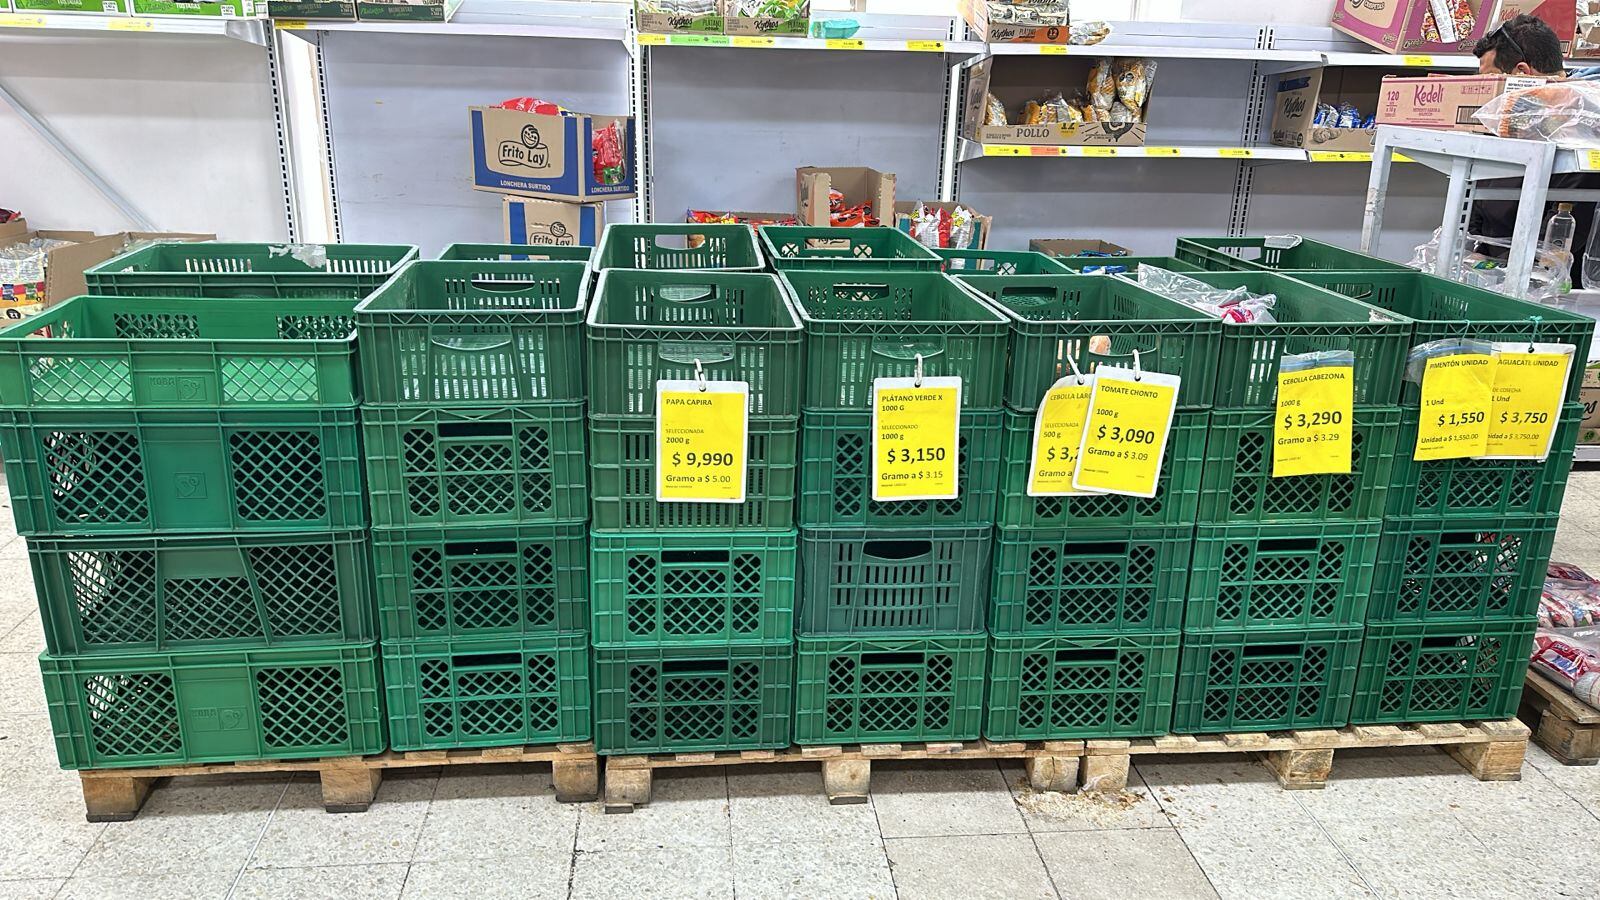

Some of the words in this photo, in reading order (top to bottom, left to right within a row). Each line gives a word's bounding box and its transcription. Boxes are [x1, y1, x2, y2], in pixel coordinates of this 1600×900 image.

[754, 20, 779, 32] Kythos
[1388, 91, 1400, 101] 120
[1413, 84, 1444, 106] Kedeli
[1284, 97, 1306, 118] Kythos
[1016, 128, 1049, 139] POLLO
[502, 145, 524, 160] Frito
[527, 150, 545, 166] Lay
[500, 180, 527, 189] LONCHERA
[528, 182, 551, 191] SURTIDO
[533, 235, 553, 245] Frito
[555, 236, 570, 246] Lay
[1429, 360, 1460, 369] PIMENTÓN
[1282, 376, 1308, 385] CEBOLLA
[1308, 373, 1345, 381] CABEZONA
[882, 394, 914, 402] PLÁTANO
[1050, 393, 1075, 401] CEBOLLA
[1101, 385, 1129, 395] TOMATE
[1130, 389, 1159, 399] CHONTO
[1280, 400, 1296, 408] 1000
[1096, 408, 1113, 417] 1000
[1114, 411, 1119, 419] g
[1437, 414, 1445, 428] $
[1448, 411, 1485, 426] 1,550
[1500, 411, 1508, 424] $
[1511, 412, 1548, 425] 3,750
[1284, 414, 1292, 430] $
[1297, 411, 1342, 429] 3,290
[1097, 424, 1107, 441] $
[1110, 426, 1155, 444] 3,090
[1277, 436, 1305, 446] Gramo
[1313, 434, 1319, 443] $
[1320, 433, 1340, 441] 3.29
[1421, 436, 1443, 444] Unidad
[672, 451, 681, 467] $
[686, 452, 733, 468] 9,990
[887, 448, 896, 464] $
[901, 447, 945, 464] 3,150
[1046, 445, 1055, 463] $
[1088, 447, 1115, 457] Gramo
[1124, 451, 1129, 460] $
[1131, 452, 1148, 461] 3.09
[666, 475, 695, 483] Gramo
[705, 475, 710, 483] $
[712, 475, 731, 483] 5.00
[881, 472, 909, 481] Gramo
[918, 471, 924, 480] $
[925, 471, 943, 479] 3.15
[1038, 469, 1066, 478] Gramo
